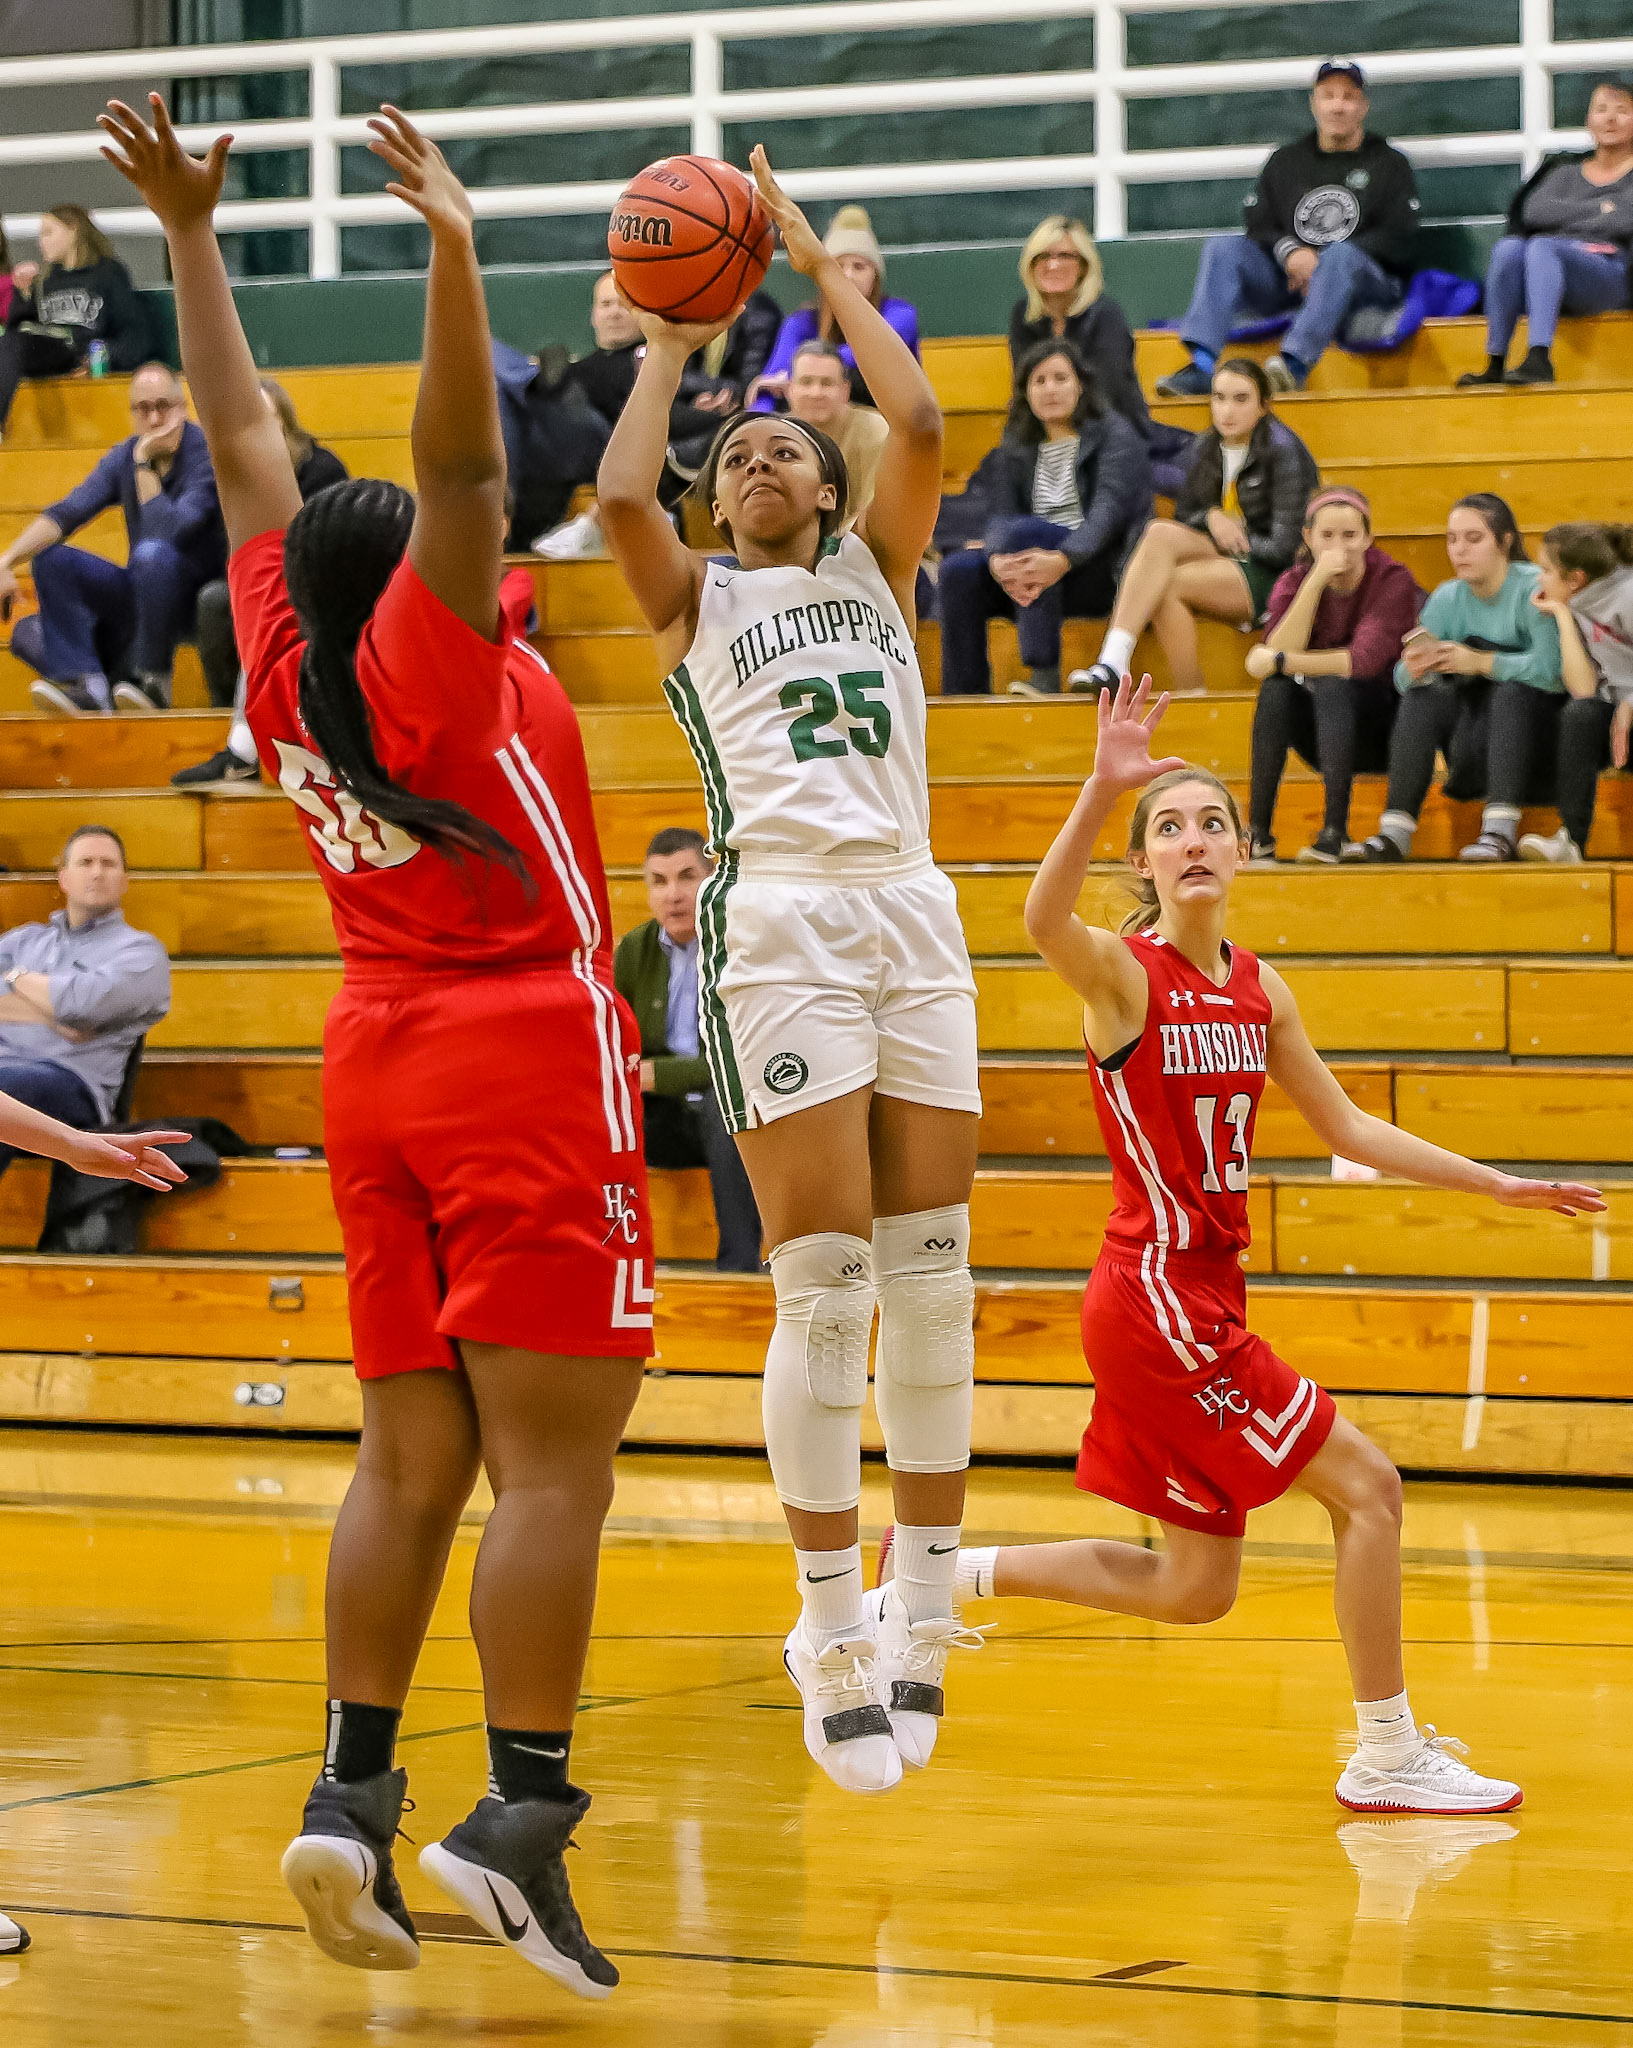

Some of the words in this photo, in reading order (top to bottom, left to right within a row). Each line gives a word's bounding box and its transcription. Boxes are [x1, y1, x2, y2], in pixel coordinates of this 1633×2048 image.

[777, 670, 892, 764] 25
[271, 737, 422, 874] 50
[1194, 1093, 1252, 1193] 13
